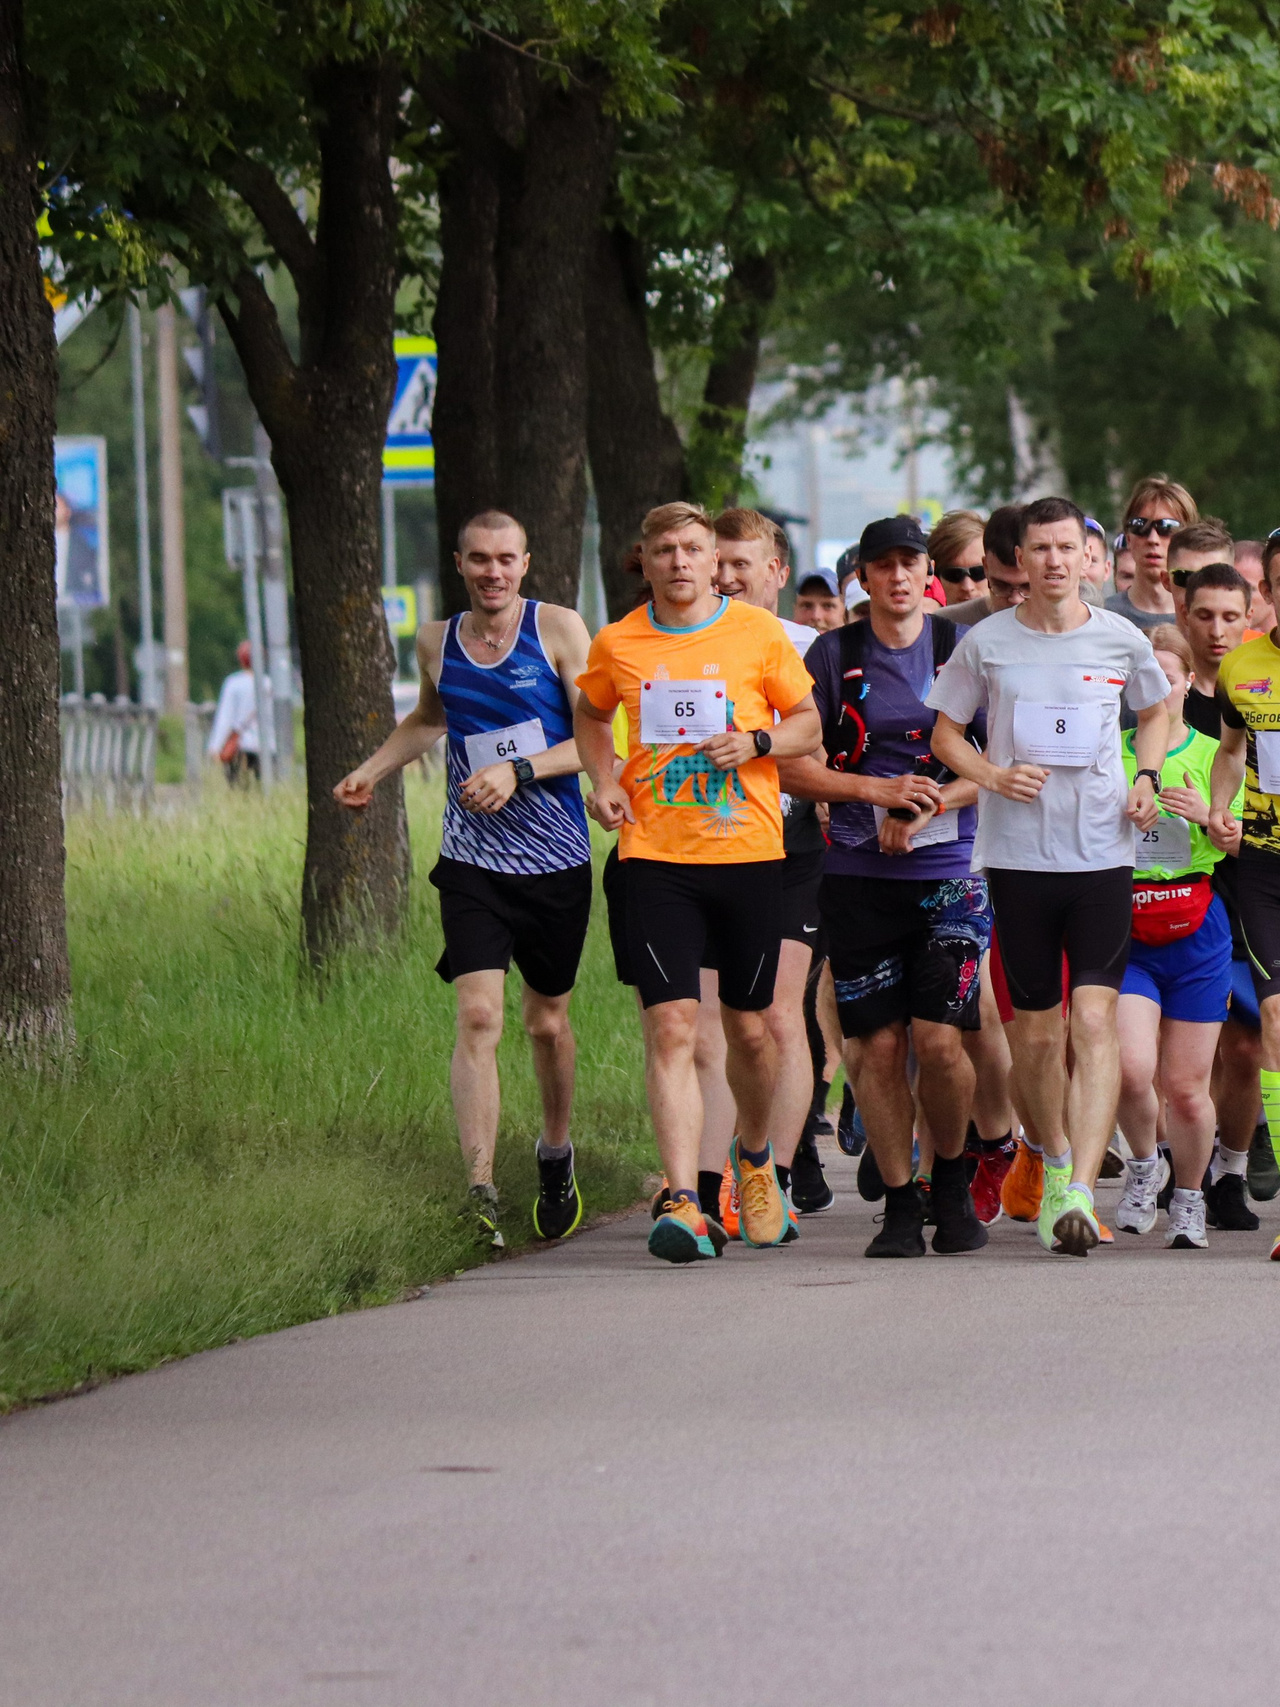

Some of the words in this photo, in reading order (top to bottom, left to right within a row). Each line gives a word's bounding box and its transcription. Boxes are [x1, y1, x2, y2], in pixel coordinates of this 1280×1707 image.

[674, 701, 695, 717] 65
[1055, 718, 1066, 734] 8
[496, 739, 518, 757] 64
[1142, 830, 1159, 843] 25
